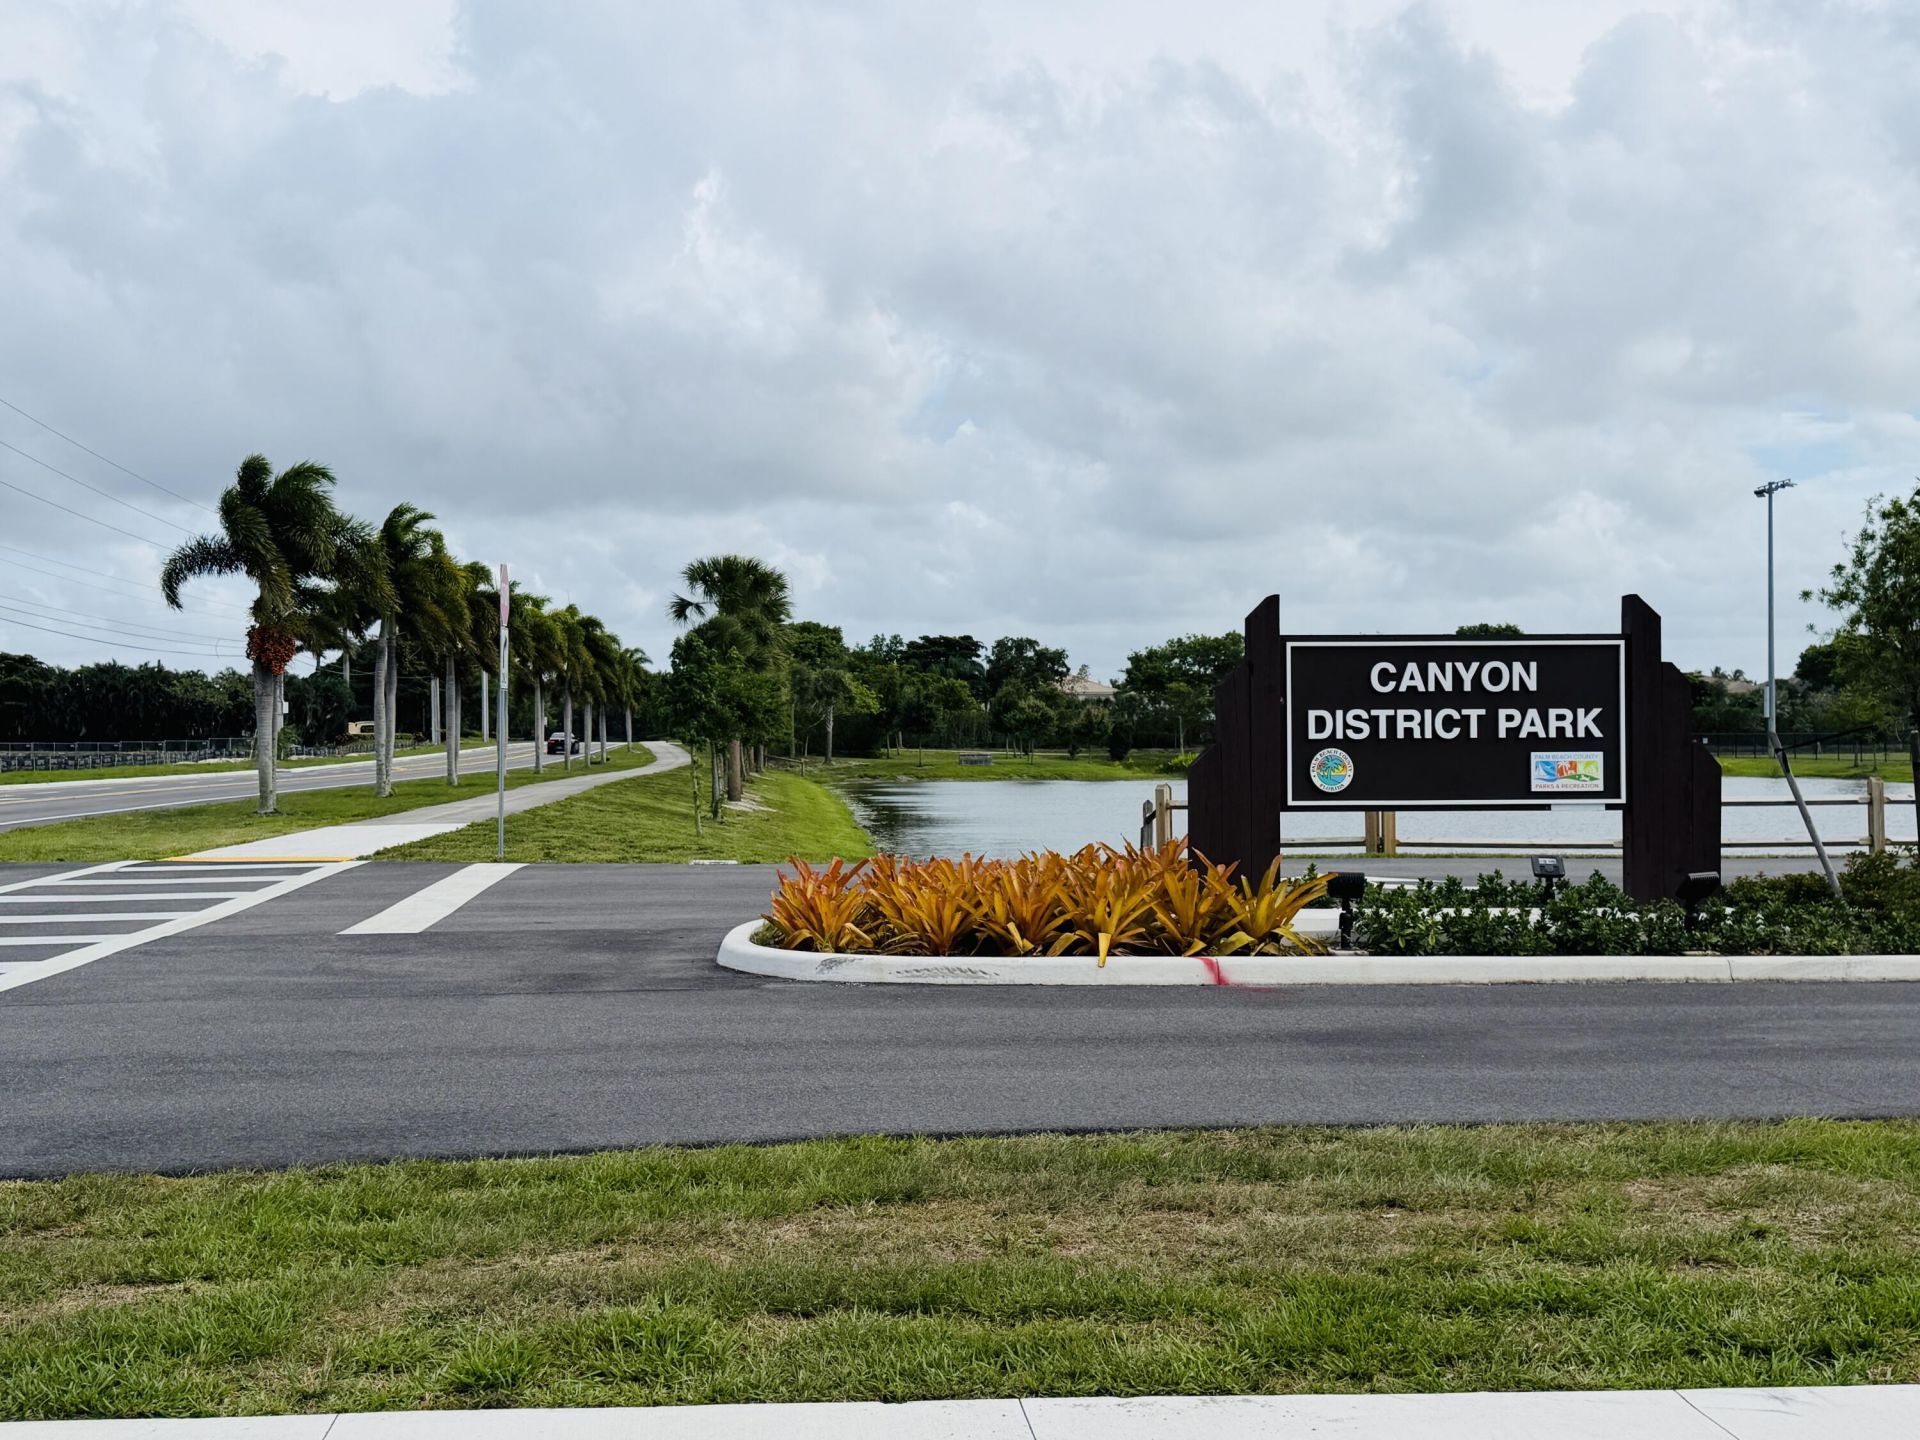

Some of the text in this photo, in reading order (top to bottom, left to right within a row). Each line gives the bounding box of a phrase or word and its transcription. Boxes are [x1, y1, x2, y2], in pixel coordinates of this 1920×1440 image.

[1370, 661, 1537, 693] CANYON
[1307, 708, 1604, 740] DISTRICT PARK
[1311, 749, 1353, 773] PALM BEACH COUNTY
[1319, 783, 1345, 792] FLORIDA
